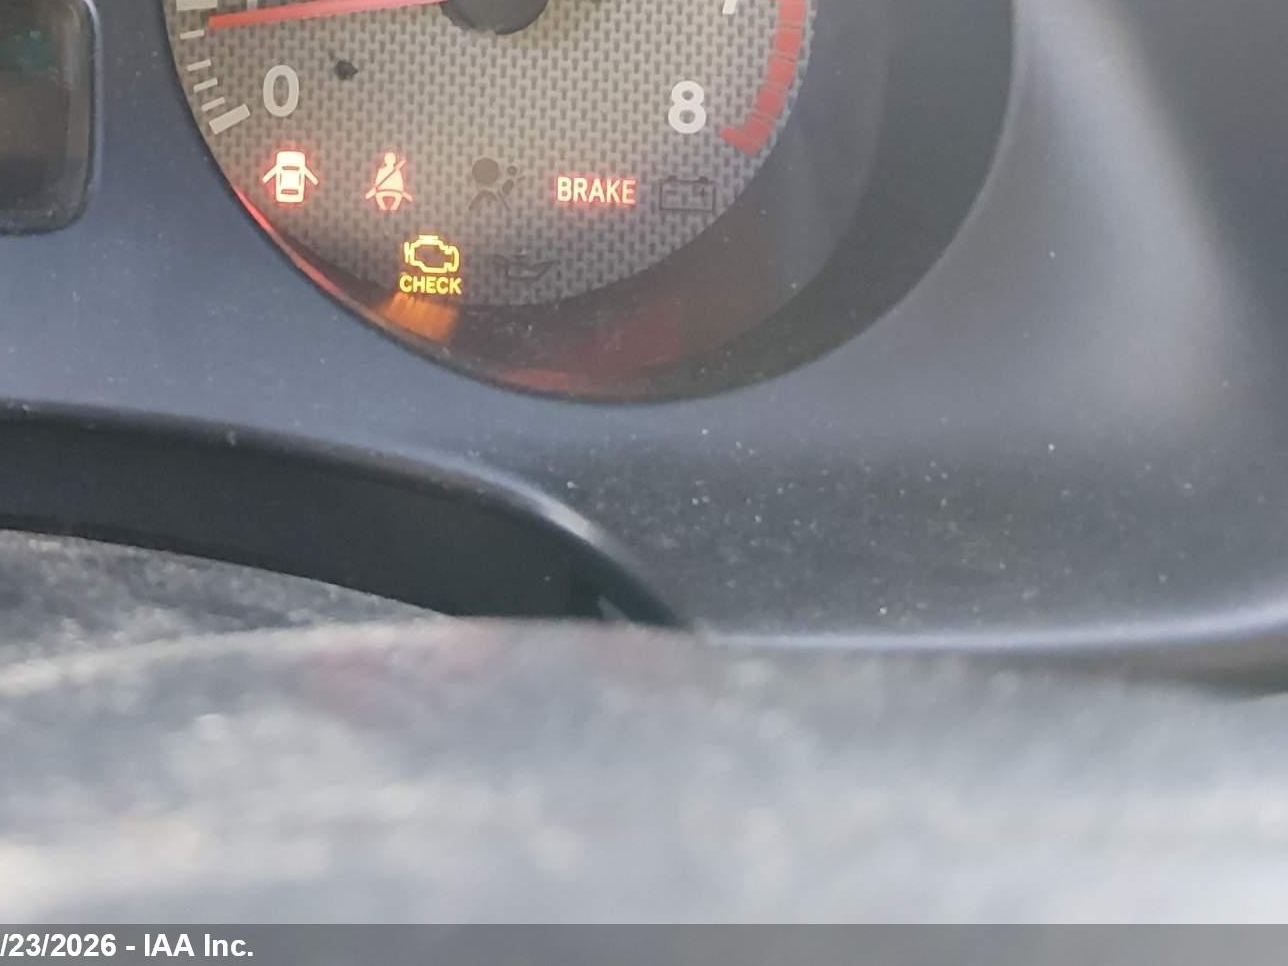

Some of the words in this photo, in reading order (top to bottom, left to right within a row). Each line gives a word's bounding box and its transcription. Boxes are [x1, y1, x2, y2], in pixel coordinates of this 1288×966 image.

[262, 64, 300, 117] 0
[667, 80, 708, 134] 8
[556, 175, 637, 206] BRAKE
[398, 273, 462, 296] CHECK
